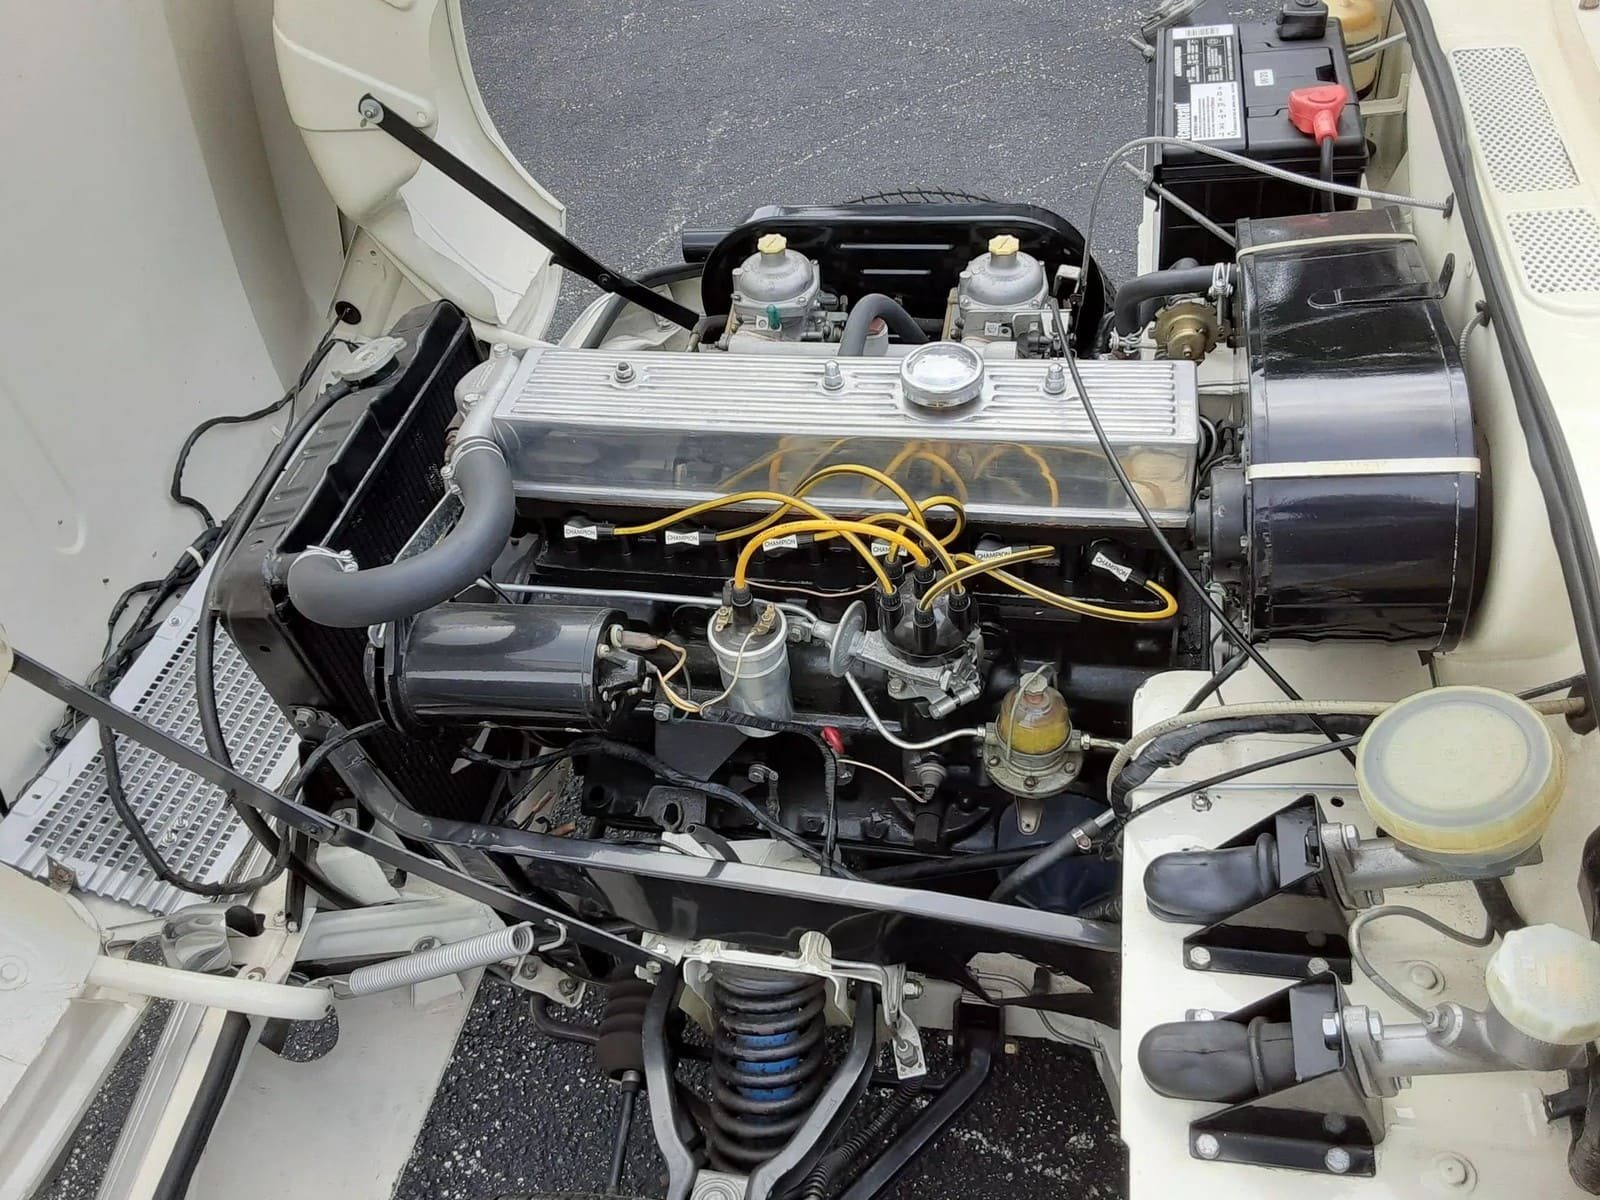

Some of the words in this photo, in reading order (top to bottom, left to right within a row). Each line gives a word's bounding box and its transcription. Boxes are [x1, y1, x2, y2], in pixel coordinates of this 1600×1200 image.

[566, 528, 595, 536] CHAMPION
[667, 534, 697, 542] CHAMPION
[764, 537, 795, 548] CHAMPION
[1095, 556, 1129, 577] CHAMPION
